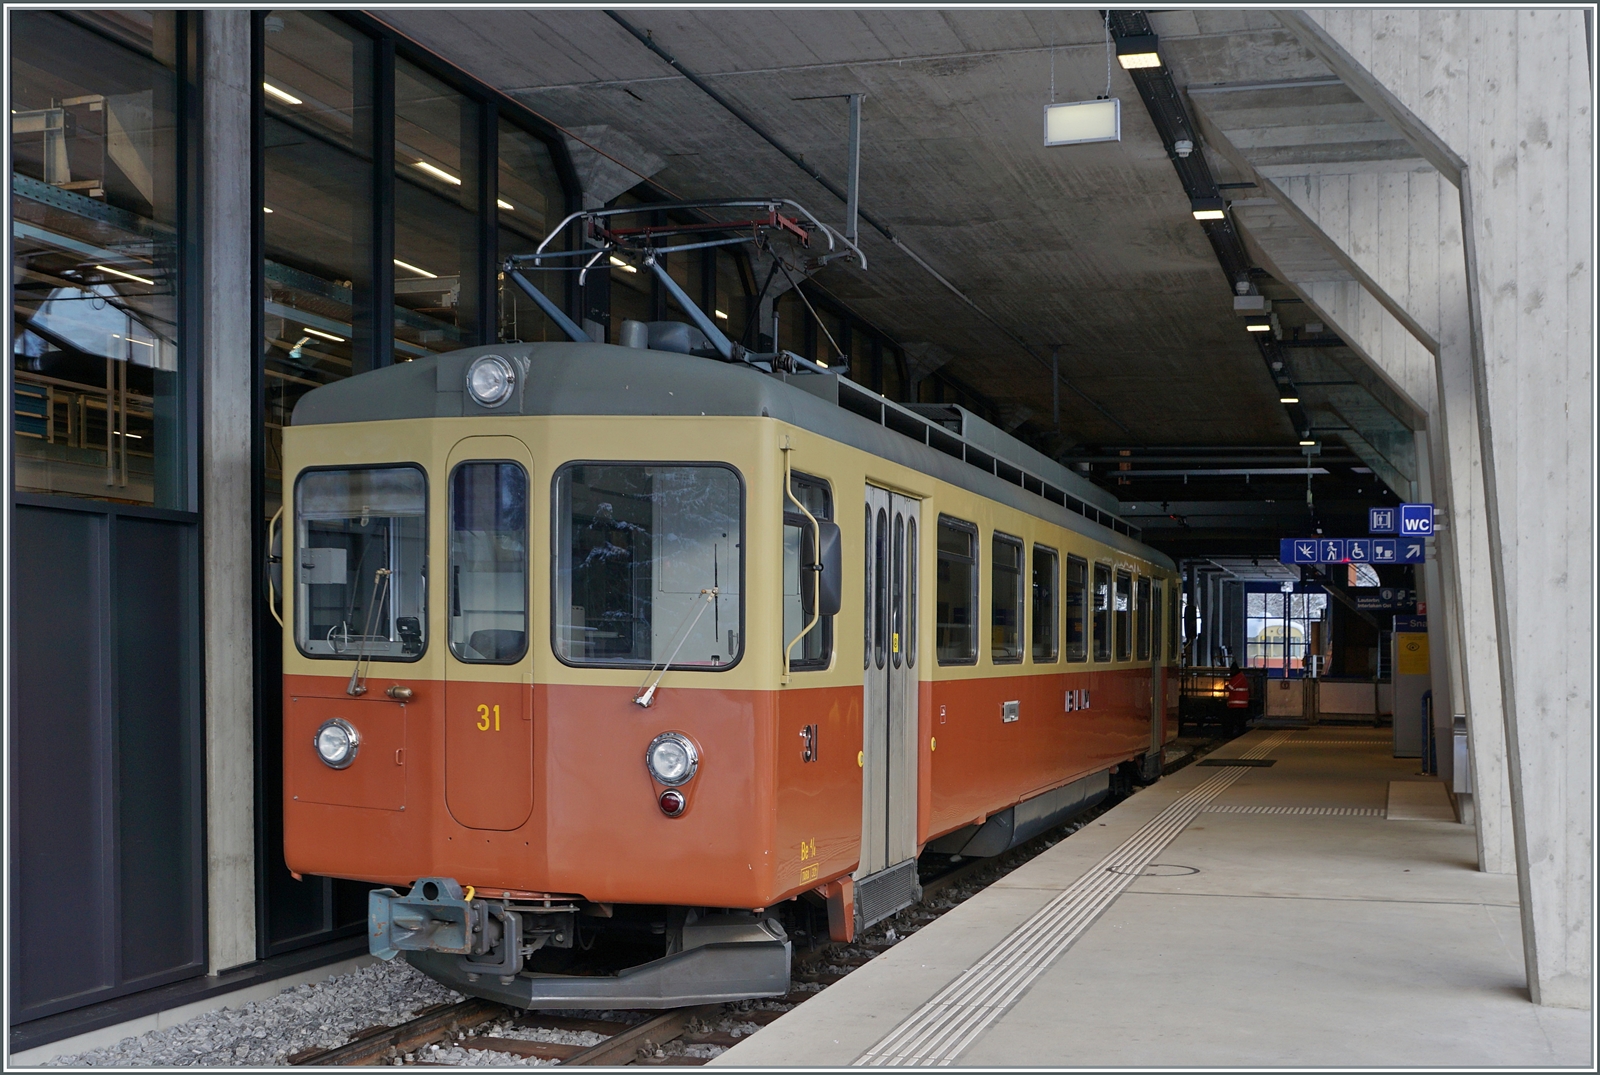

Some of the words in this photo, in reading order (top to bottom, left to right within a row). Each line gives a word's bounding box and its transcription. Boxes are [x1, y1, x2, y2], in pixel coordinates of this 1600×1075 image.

[1405, 518, 1429, 531] WC
[477, 703, 500, 731] 31
[799, 724, 818, 763] 31
[801, 841, 809, 861] Be
